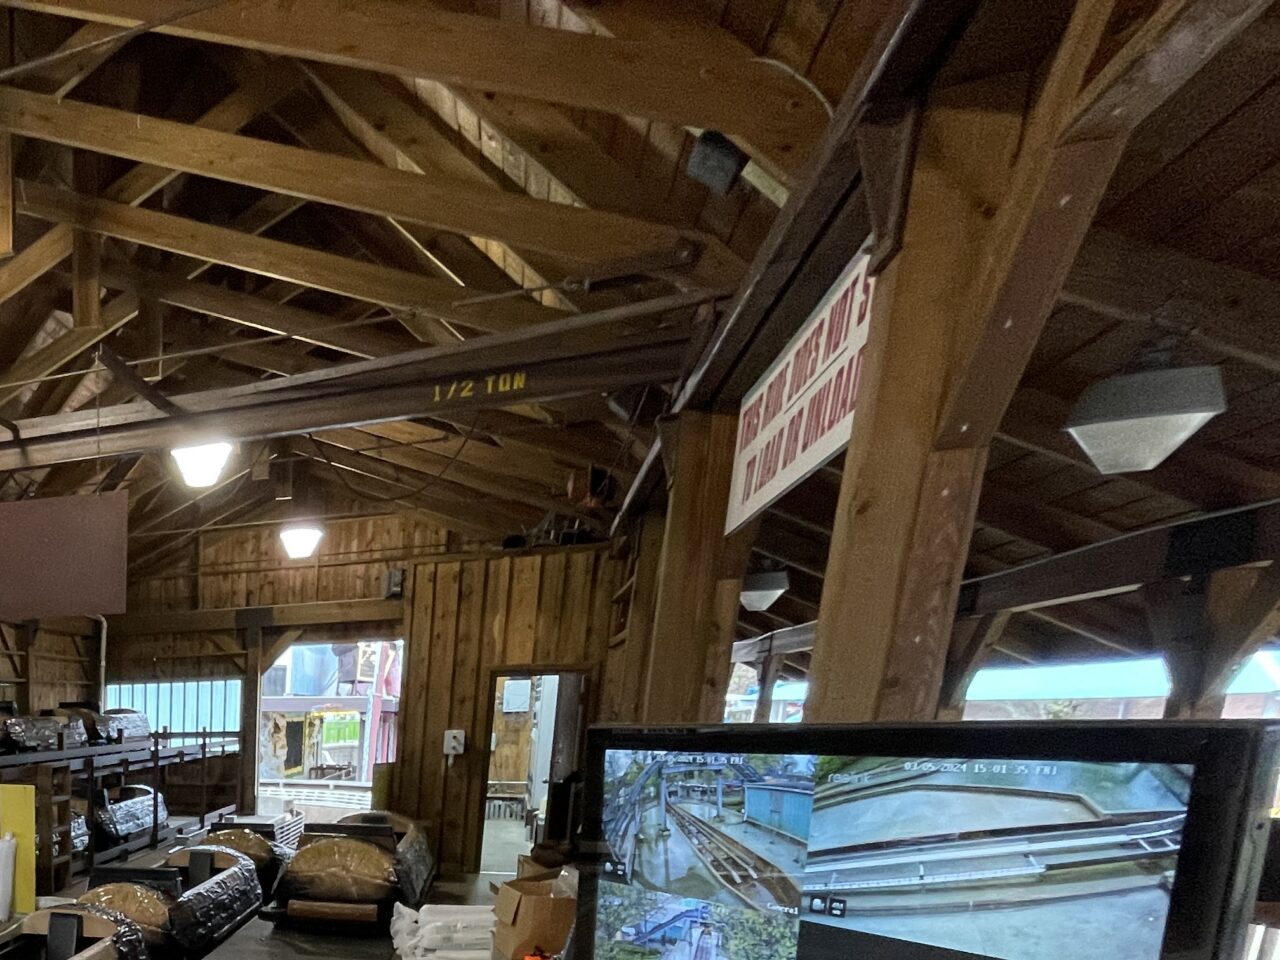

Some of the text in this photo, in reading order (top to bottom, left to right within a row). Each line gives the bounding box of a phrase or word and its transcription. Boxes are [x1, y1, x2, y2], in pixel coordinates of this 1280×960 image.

[433, 371, 526, 402] 1/2 TON
[739, 272, 860, 454] THIS RIDE DOES NOT
[742, 453, 757, 505] TO
[754, 426, 785, 495] LOAD
[782, 406, 804, 470] OR
